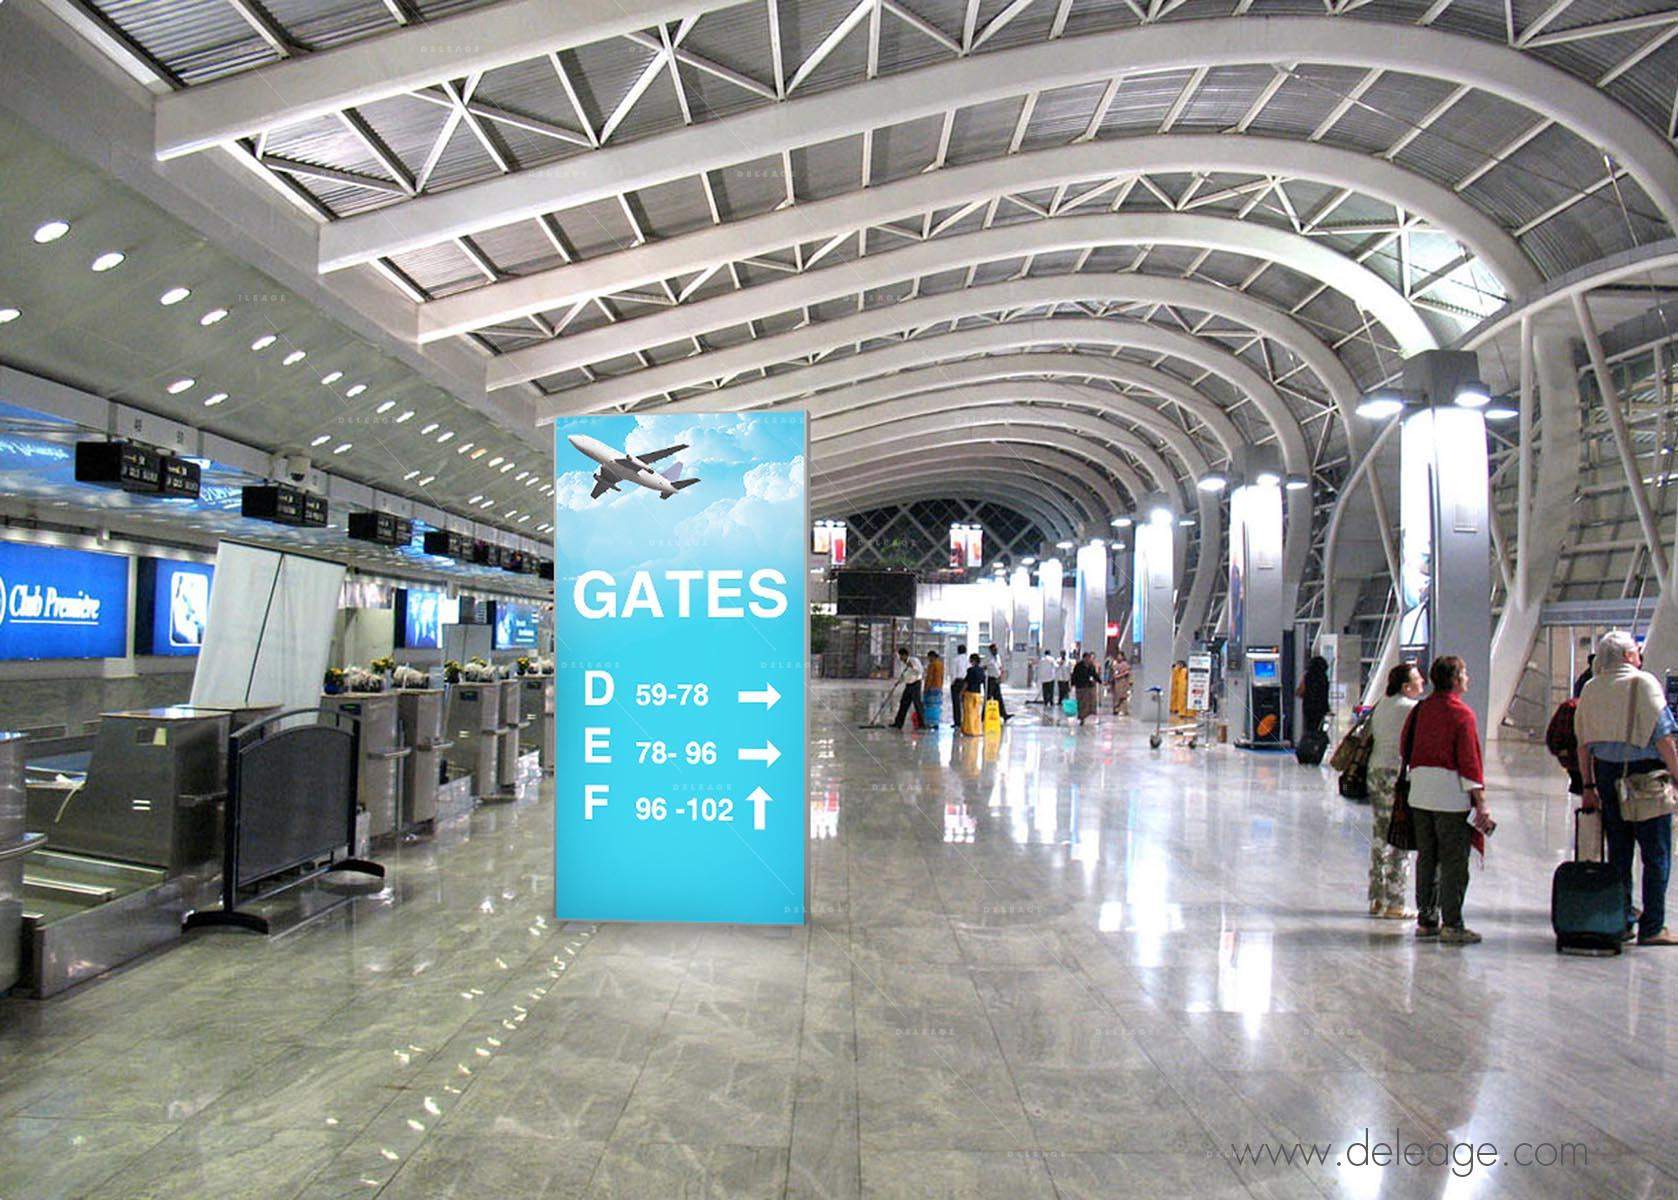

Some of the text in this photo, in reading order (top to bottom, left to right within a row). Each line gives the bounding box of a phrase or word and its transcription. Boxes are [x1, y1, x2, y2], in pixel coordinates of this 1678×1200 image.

[574, 569, 787, 618] GATES
[584, 669, 709, 706] D 59-78
[584, 727, 717, 765] E 78- 96
[584, 785, 734, 822] F 96 -102
